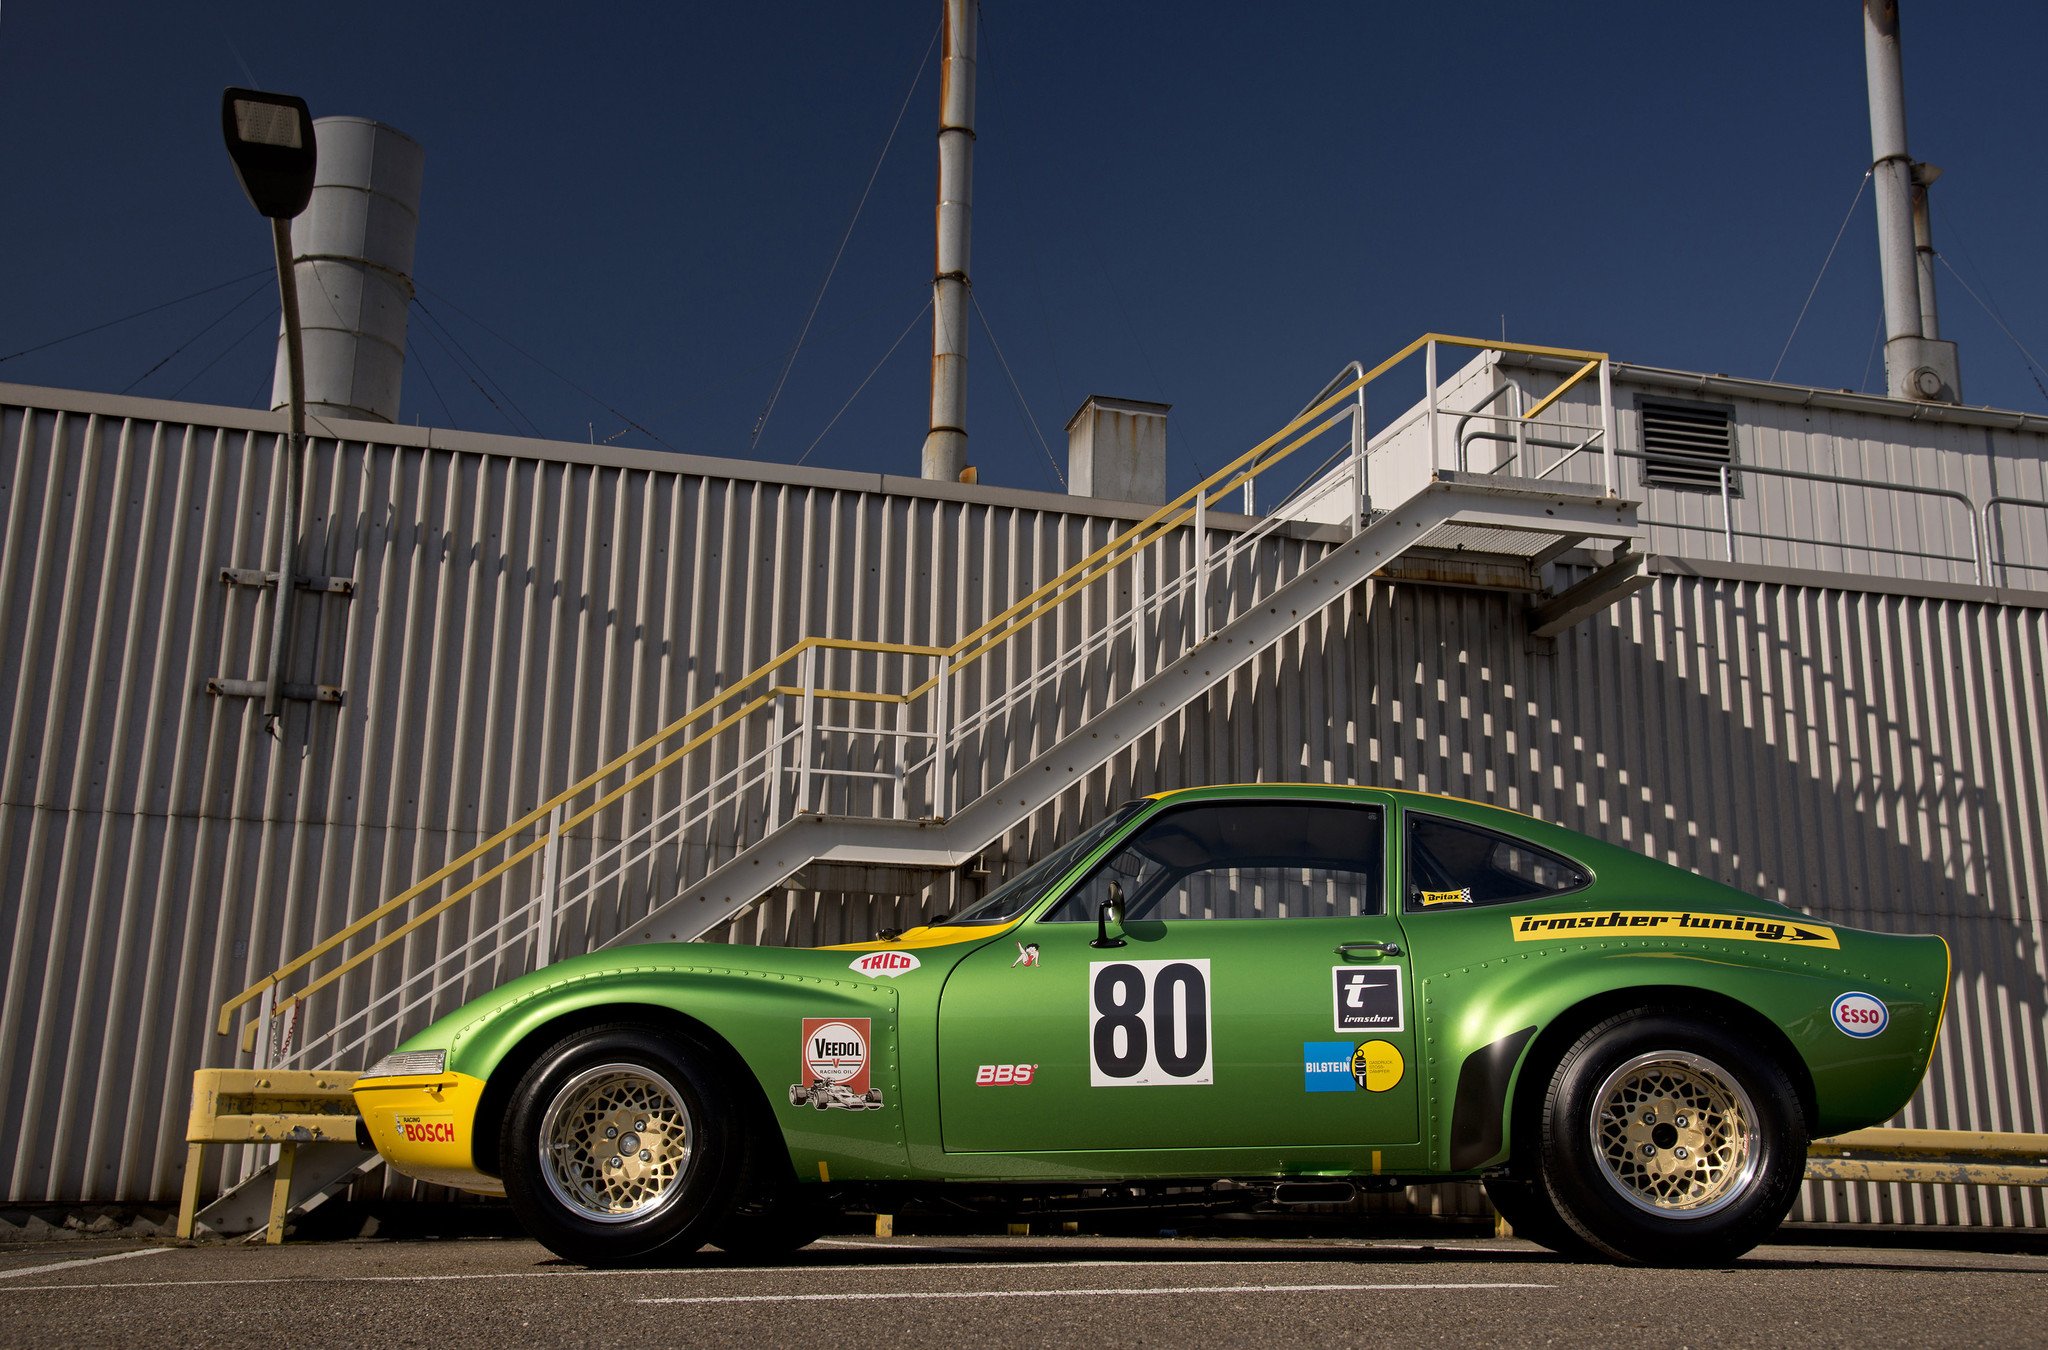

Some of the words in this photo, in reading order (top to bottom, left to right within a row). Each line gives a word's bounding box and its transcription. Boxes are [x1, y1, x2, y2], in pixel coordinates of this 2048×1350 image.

[1427, 893, 1459, 901] Britax
[1519, 912, 1669, 932] irmscher
[1671, 912, 1788, 940] tuning
[861, 953, 911, 969] TRICO
[1094, 963, 1207, 1078] 80
[1344, 1014, 1394, 1023] irmscher
[976, 1064, 1034, 1086] BBS
[1305, 1062, 1350, 1072] BILSTEIN
[405, 1123, 455, 1142] BOSCH
